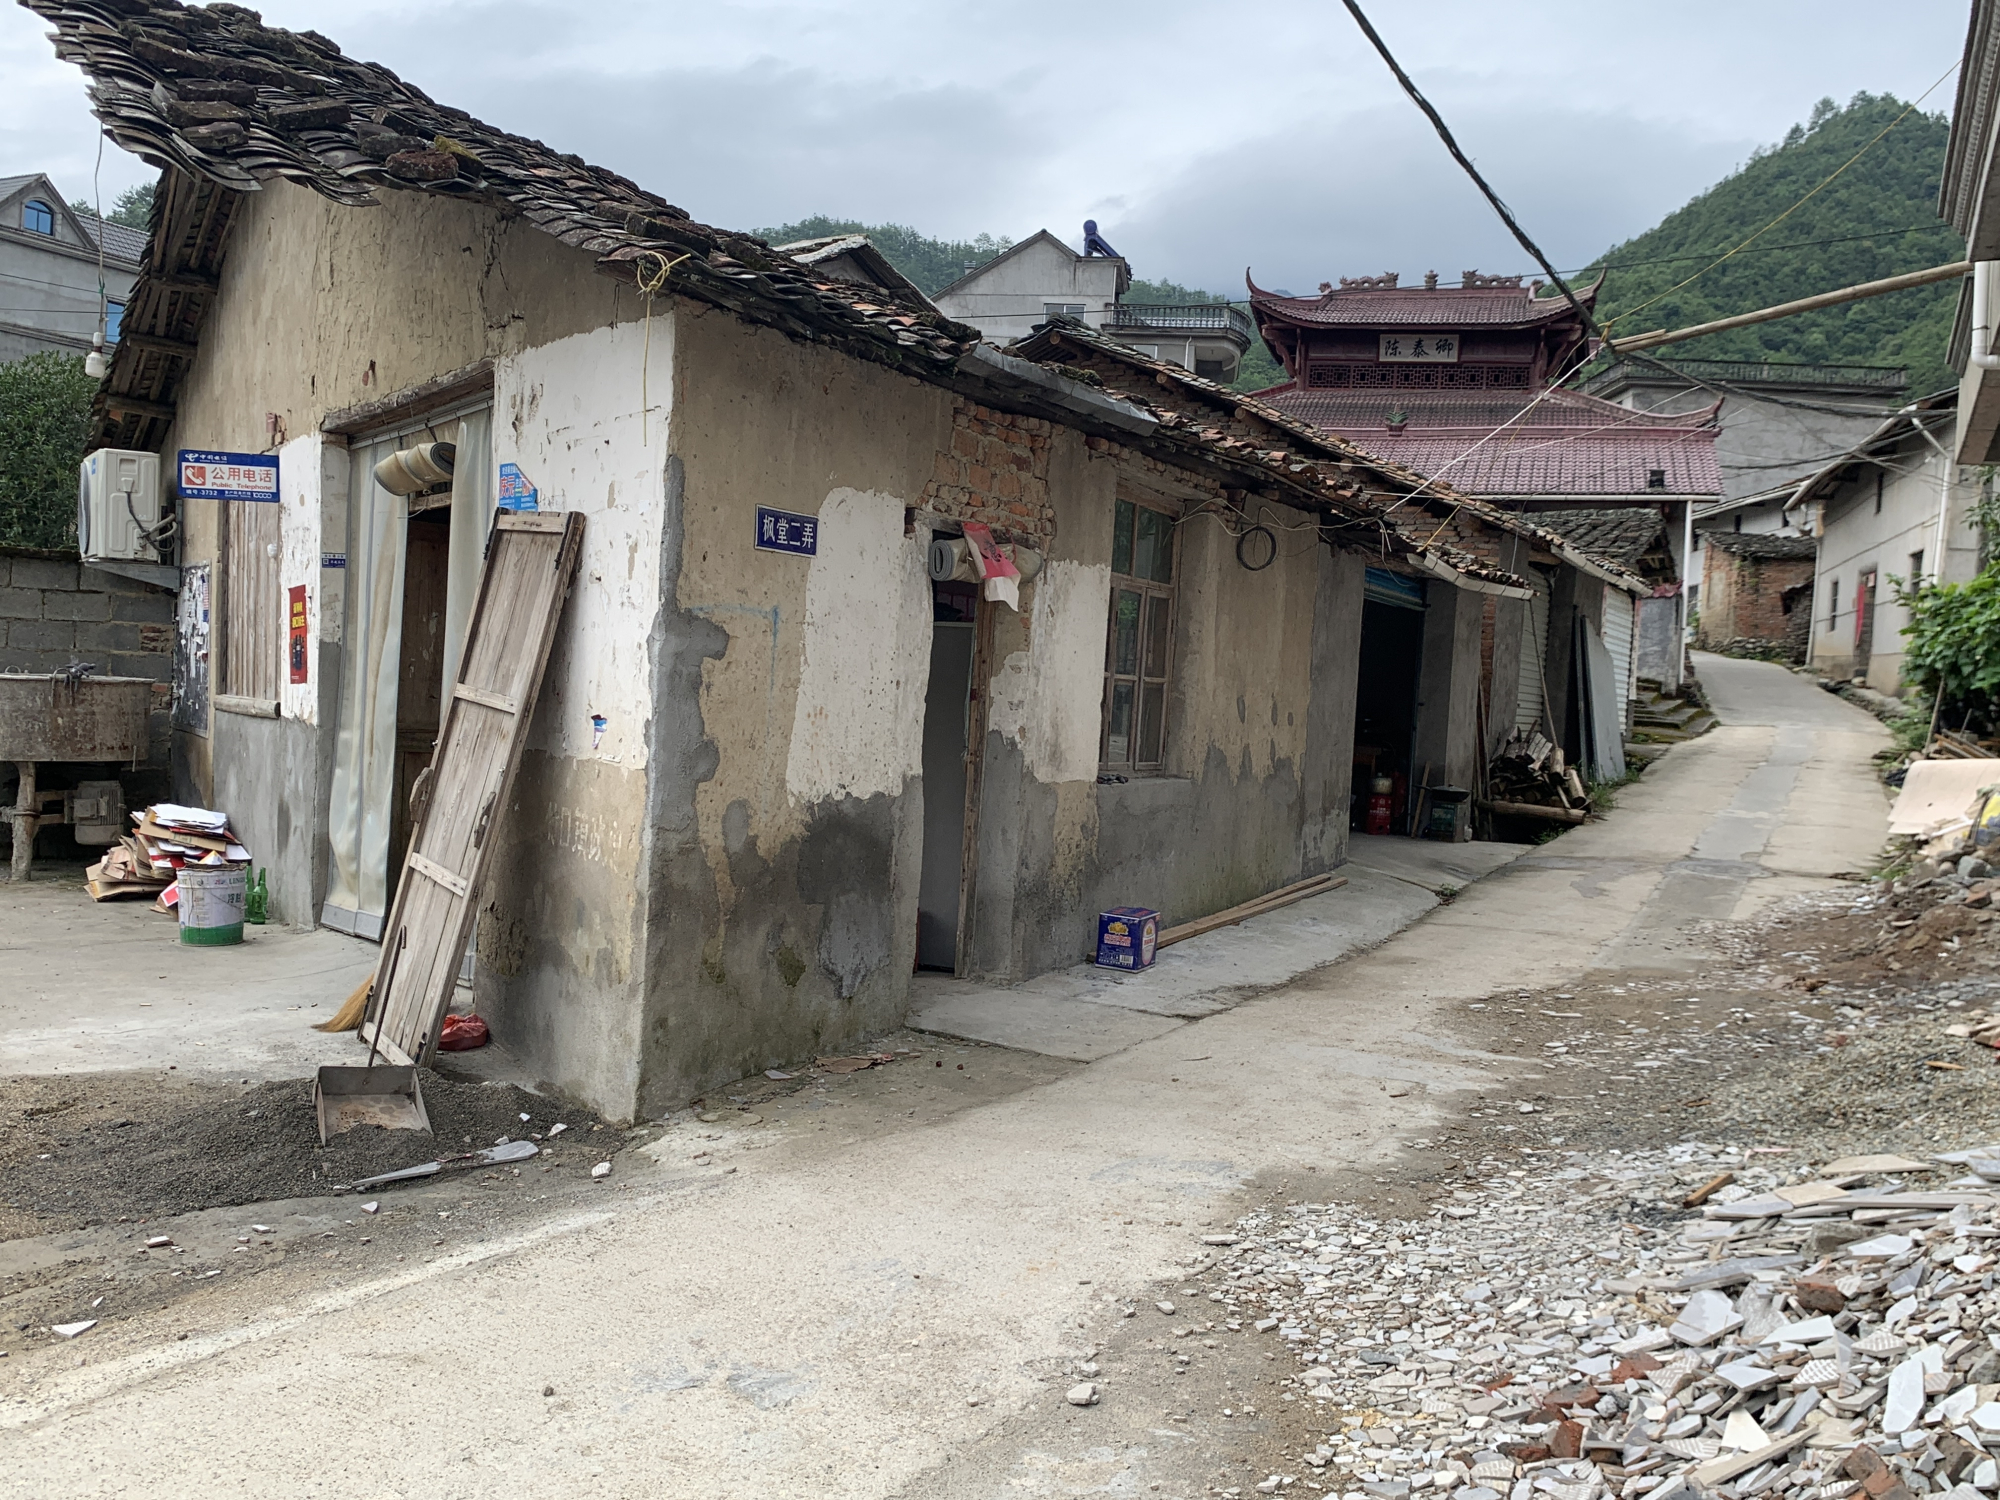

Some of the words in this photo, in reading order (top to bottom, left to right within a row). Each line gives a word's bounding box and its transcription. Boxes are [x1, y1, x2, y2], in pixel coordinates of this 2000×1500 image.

[211, 466, 273, 483] 公用电话
[763, 514, 813, 548] 枫堂二弄
